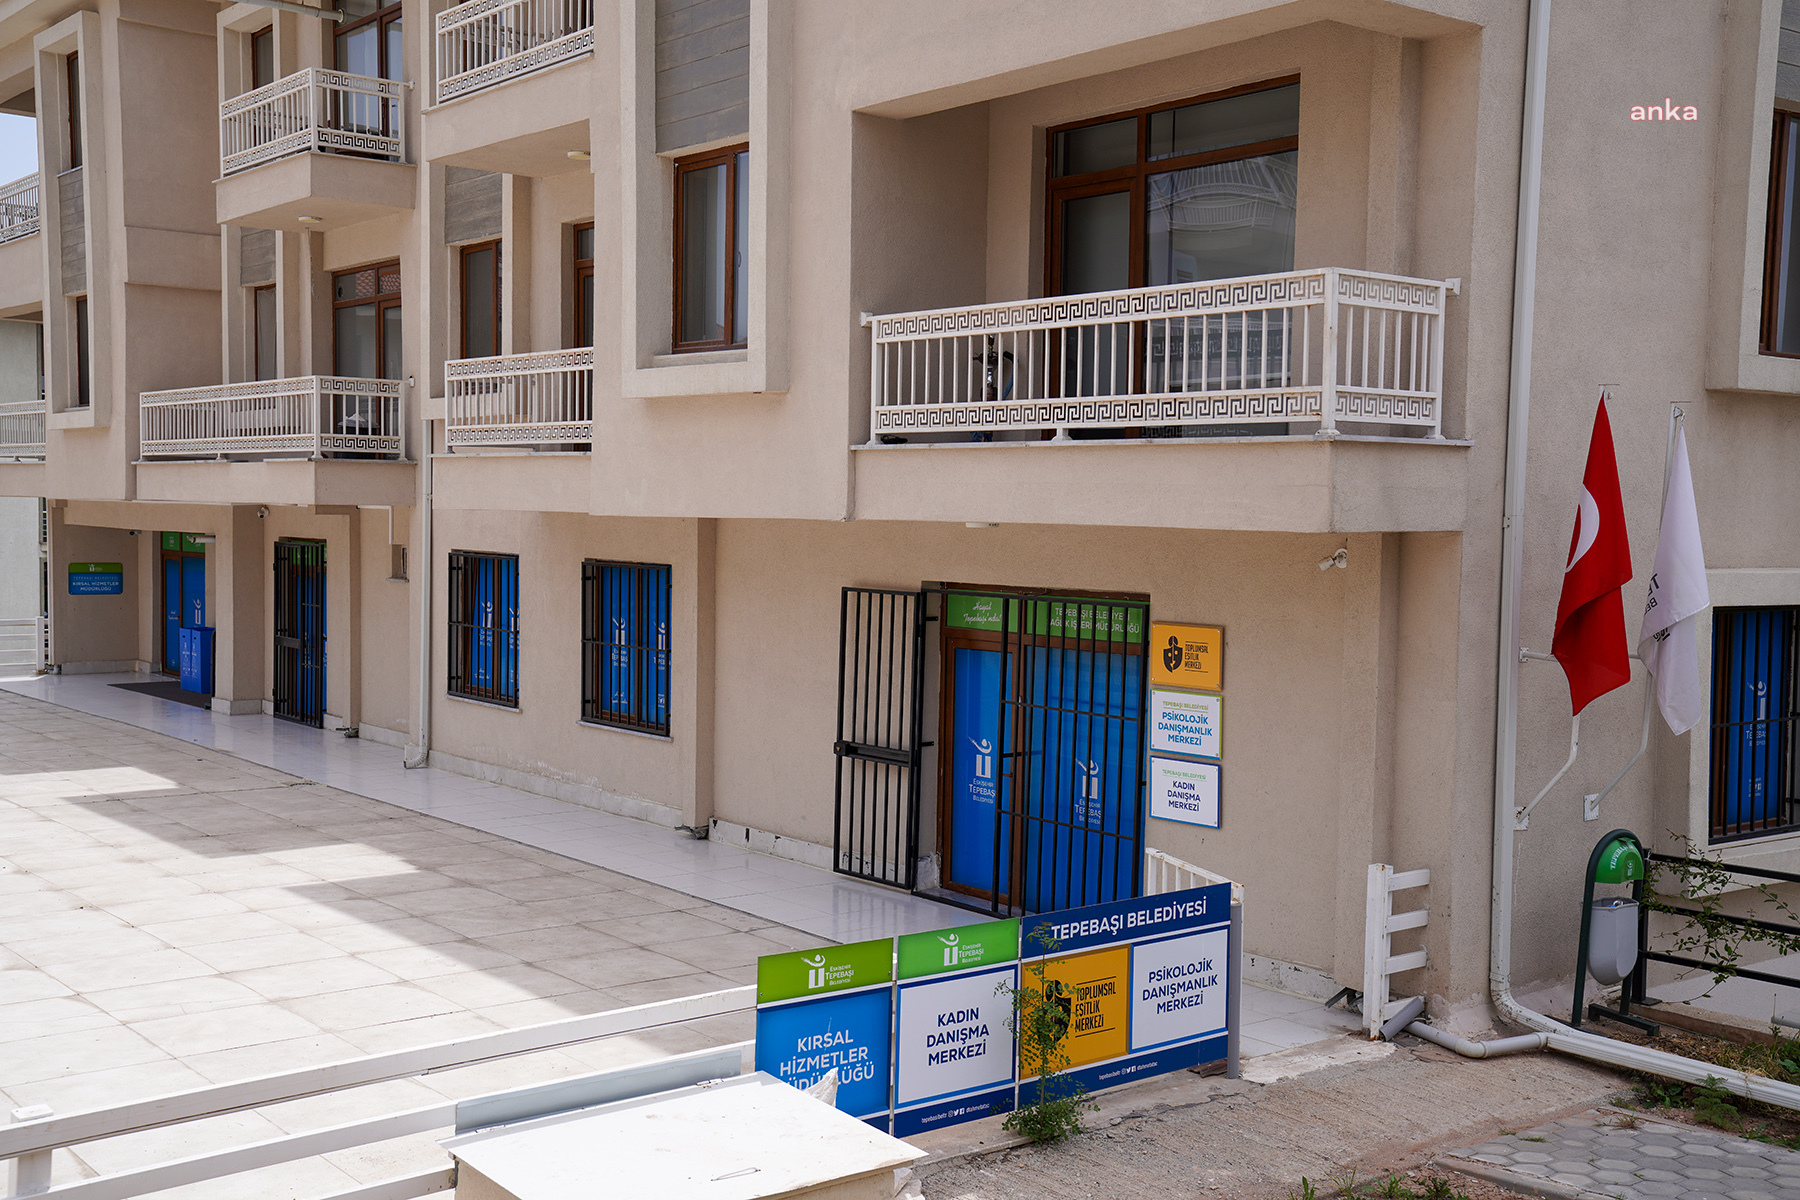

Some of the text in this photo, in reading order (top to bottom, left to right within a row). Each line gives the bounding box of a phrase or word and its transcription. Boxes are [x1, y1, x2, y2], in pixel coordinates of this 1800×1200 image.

[1055, 607, 1130, 621] TEEBŞI BELEİYEİ
[1071, 618, 1093, 630] İŞERİ
[1162, 701, 1208, 710] TEPEBAŞI BELEDİYESİ
[1162, 711, 1208, 725] PSİKOLOJİK
[1158, 722, 1212, 737] DANIŞMANLIK
[1168, 734, 1202, 746] MERKEZİ
[969, 784, 996, 799] TEPEBAŞ
[1173, 781, 1195, 791] KADIN
[1167, 790, 1201, 802] DANIŞMA
[1168, 800, 1200, 812] MERKEZİ
[1051, 896, 1206, 941] TEPEBAŞI BELEDİYESİ
[959, 948, 984, 958] TEPEBAŞI
[825, 969, 854, 980] TEPEBAŞI
[1148, 958, 1213, 983] PSİKOLOJİK
[1076, 981, 1116, 1001] TOPLUMSAL
[1142, 974, 1218, 1001] DANIŞMANLIK
[1156, 991, 1204, 1014] MERKEZİ
[937, 1007, 979, 1027] KADIN
[1075, 1014, 1104, 1032] MERKEZİ
[797, 1029, 853, 1053] KIRSAL
[926, 1024, 989, 1048] DANIŞMA
[928, 1039, 986, 1066] MERKEZİ
[780, 1046, 868, 1076] HİZMETLER
[787, 1061, 874, 1090] ÜDÜÜĞÜ
